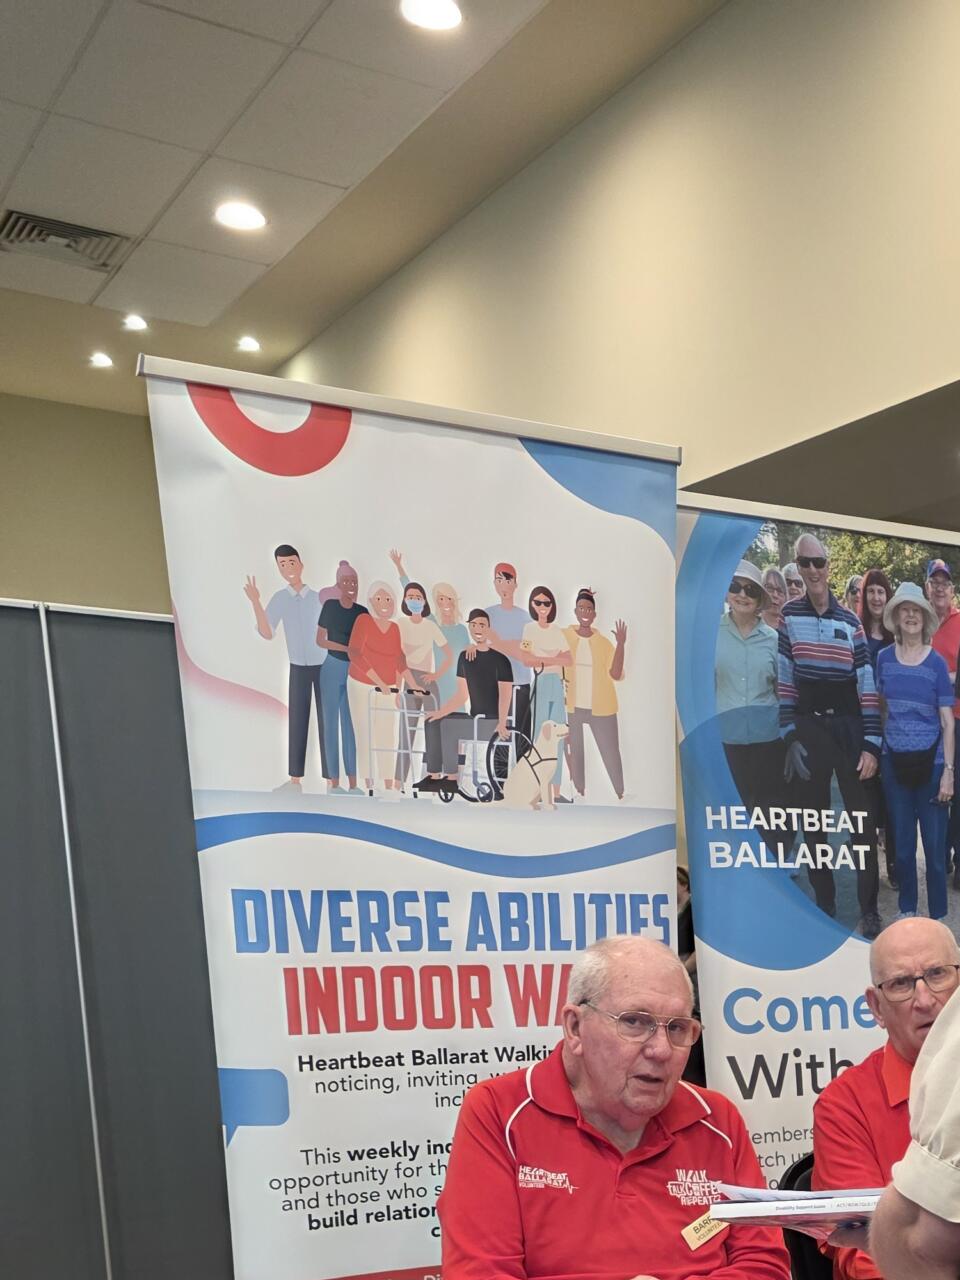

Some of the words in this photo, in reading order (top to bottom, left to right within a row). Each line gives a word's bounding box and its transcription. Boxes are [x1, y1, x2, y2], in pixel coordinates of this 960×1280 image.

[705, 806, 868, 834] HEARTBEAT
[708, 842, 871, 870] BALLARAT
[231, 889, 452, 954] DIVERSE
[465, 892, 671, 952] ABILITIES
[283, 964, 494, 1036] INDOOR
[723, 987, 878, 1035] Come
[297, 1051, 404, 1072] Heartbeat
[412, 1047, 489, 1066] Ballarat
[494, 1045, 554, 1062] Walki
[315, 1075, 400, 1094] noticing,
[747, 1126, 814, 1144] embers
[300, 1148, 341, 1166] This
[347, 1140, 420, 1161] weekly
[757, 1151, 785, 1167] tch
[269, 1166, 388, 1195] opportunity
[394, 1162, 422, 1178] for
[676, 1169, 708, 1182] WALK
[282, 1192, 320, 1211] and
[325, 1190, 381, 1208] those
[387, 1183, 427, 1200] who
[308, 1208, 358, 1231] build
[365, 1203, 438, 1224] relatio
